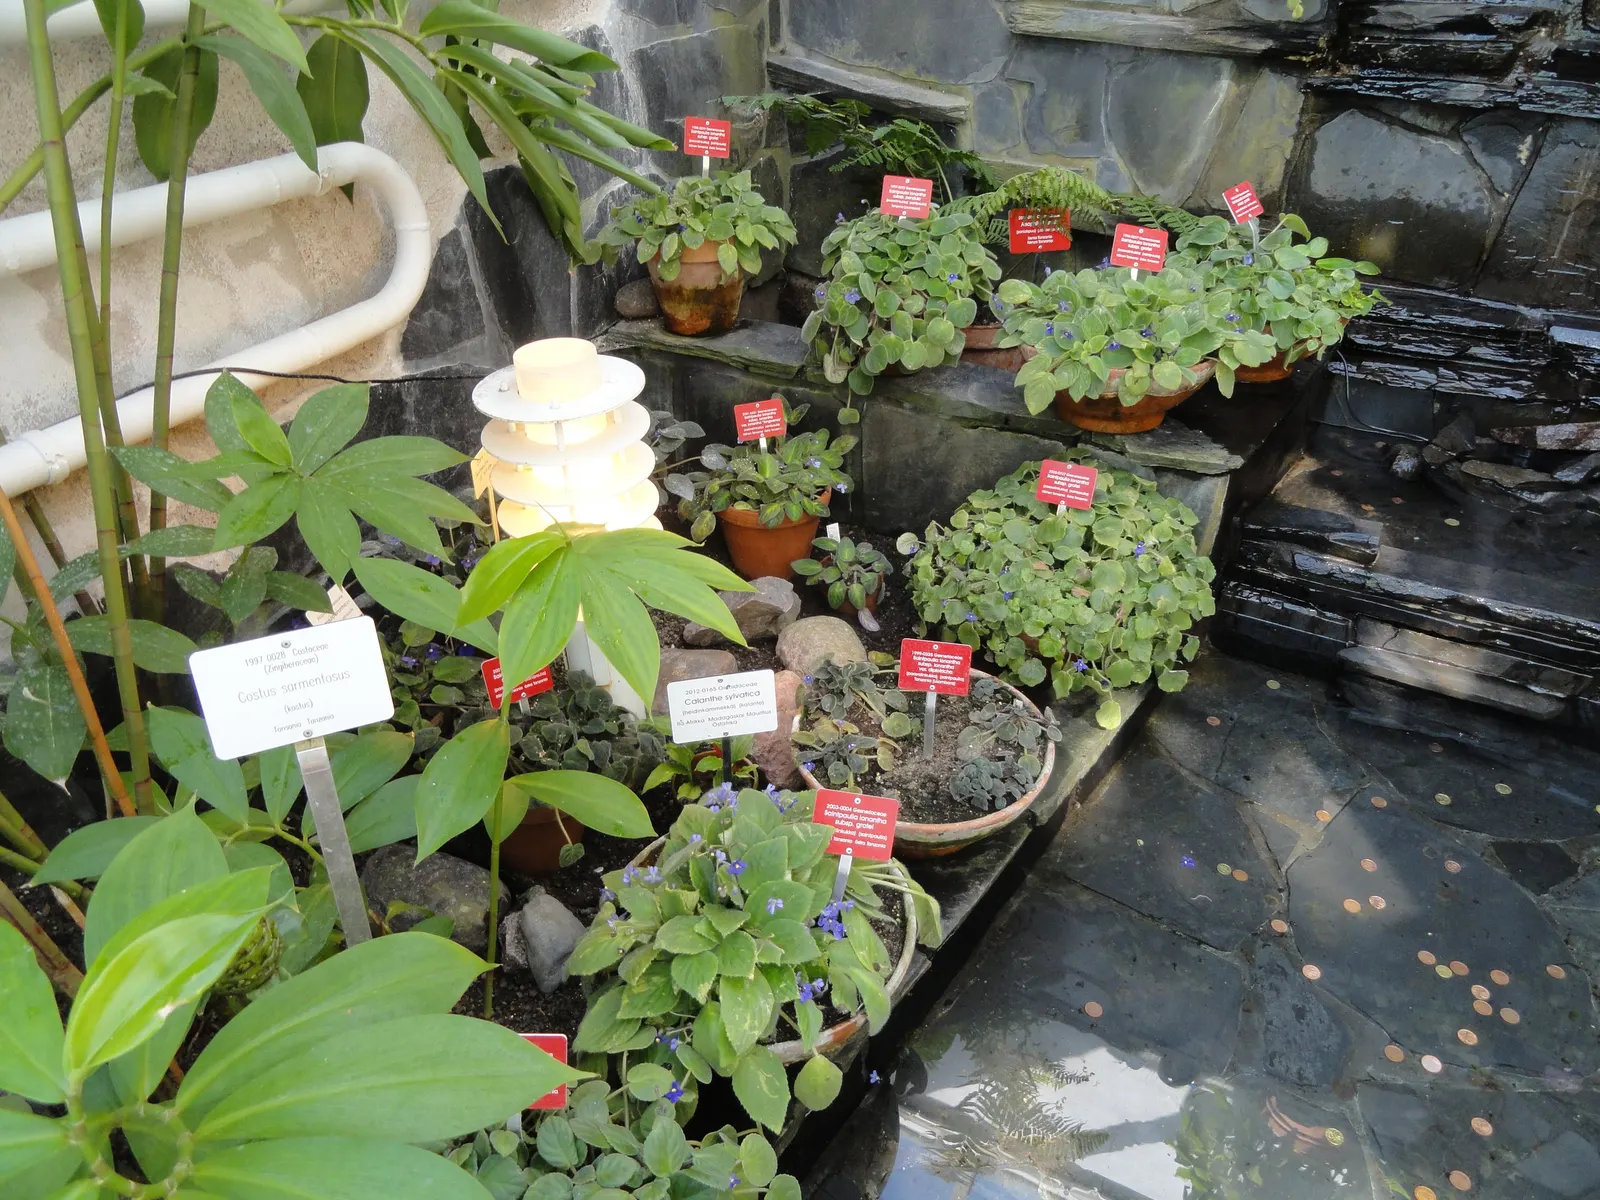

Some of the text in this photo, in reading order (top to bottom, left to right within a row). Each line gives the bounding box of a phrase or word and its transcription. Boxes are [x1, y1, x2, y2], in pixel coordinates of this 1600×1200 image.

[245, 656, 263, 667] 1997
[292, 643, 329, 657] Costaceae
[264, 656, 319, 674] (Zingiberaceae)
[238, 670, 350, 703] Costus sarmentosus
[685, 690, 761, 705] Calanthe sylvatica
[284, 699, 314, 714] (kostus)
[824, 810, 887, 824] Saintpaulia ionantha
[835, 819, 854, 827] subsp.
